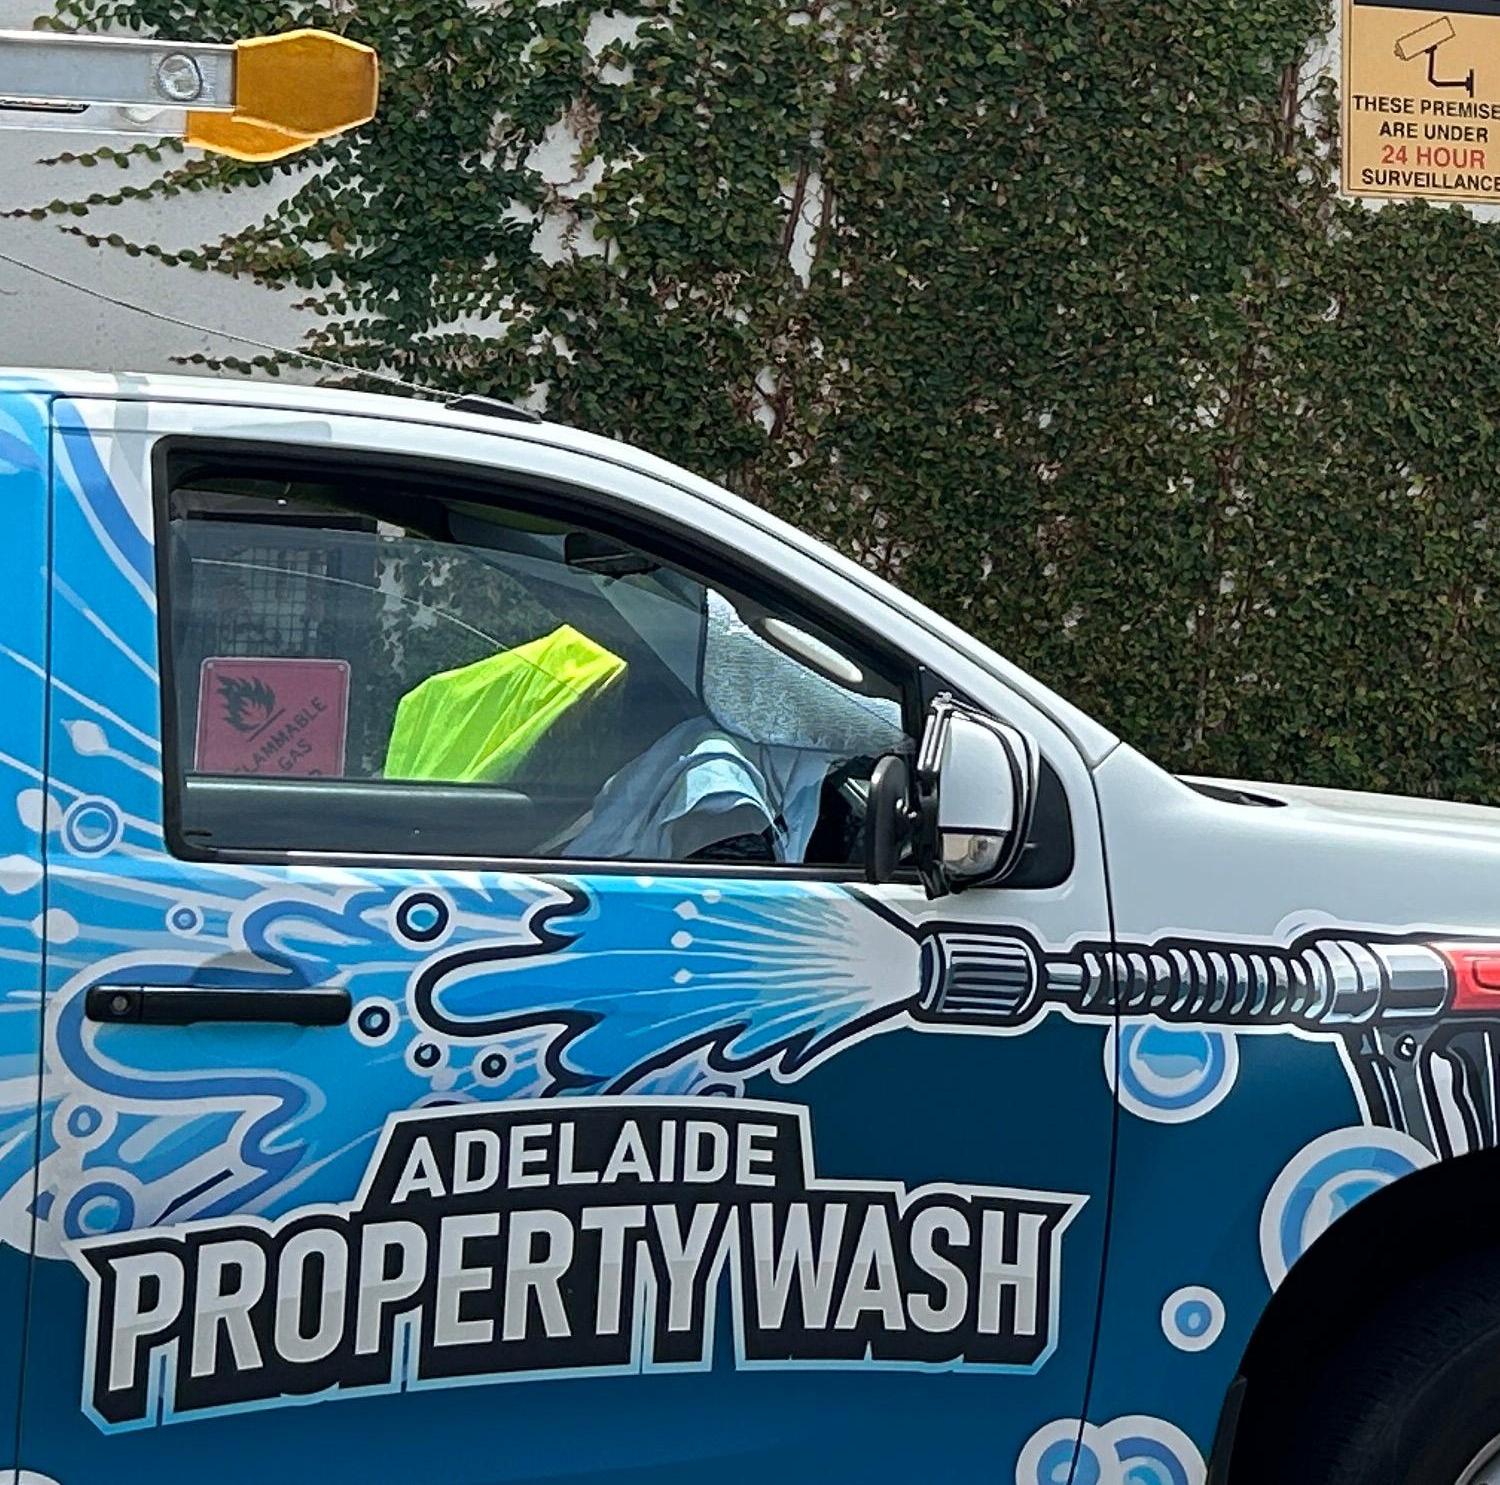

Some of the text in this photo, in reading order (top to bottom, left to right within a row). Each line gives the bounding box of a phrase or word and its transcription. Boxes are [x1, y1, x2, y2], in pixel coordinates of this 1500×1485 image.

[1353, 95, 1414, 115] THESE
[1379, 121, 1488, 143] ARE UNDER
[1381, 145, 1486, 169] 24 HOUR
[234, 696, 328, 773] LAMMABLE
[278, 739, 313, 772] GAS
[391, 1120, 777, 1202] ADELAIDE
[111, 1200, 1050, 1391] PROPERTY WASH
